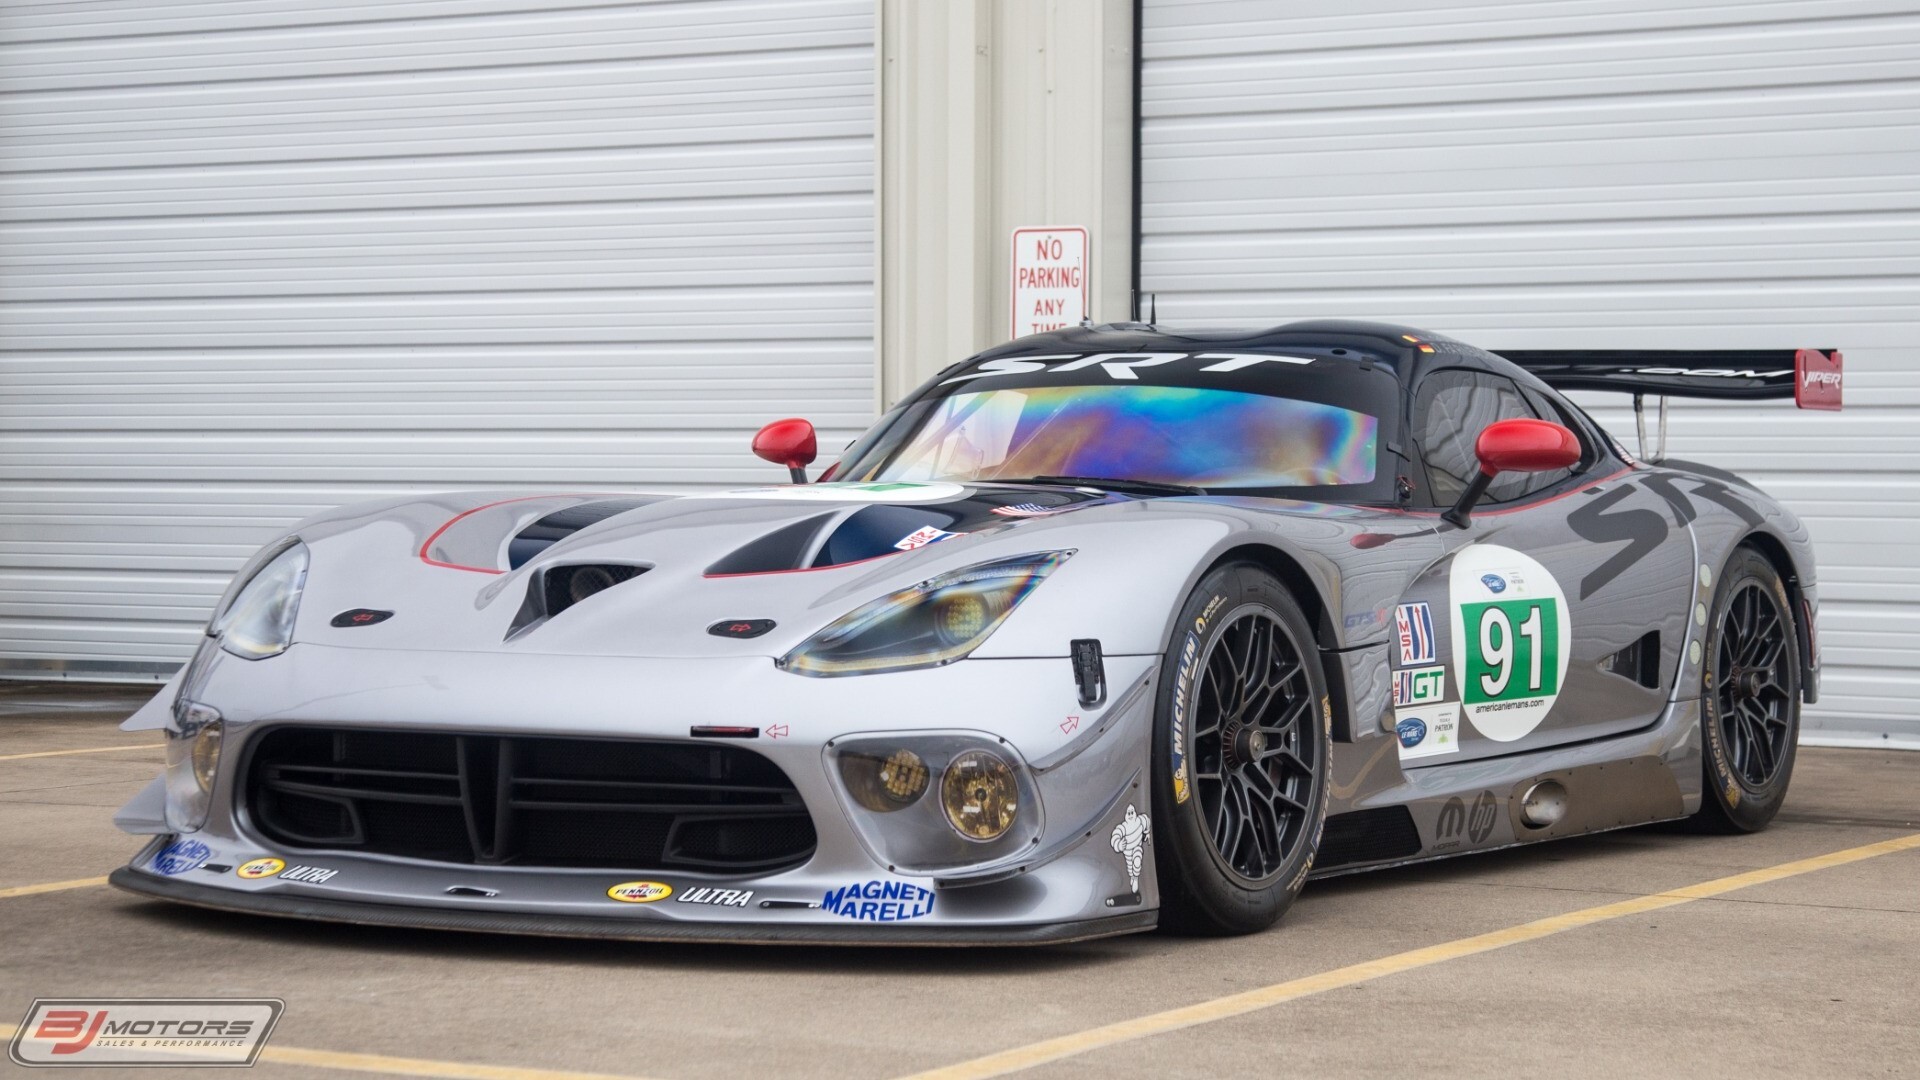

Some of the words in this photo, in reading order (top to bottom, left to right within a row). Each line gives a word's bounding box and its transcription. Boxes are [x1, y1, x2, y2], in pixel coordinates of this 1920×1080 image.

[1037, 239, 1063, 260] NO
[1019, 267, 1081, 289] PARKING
[1034, 299, 1065, 316] ANY
[938, 353, 1316, 386] SRT
[1801, 370, 1841, 390] VIPER
[1398, 606, 1413, 661] IMSA
[1479, 605, 1542, 698] 91
[1174, 636, 1196, 755] MICHELIN
[1413, 670, 1444, 699] GT
[280, 865, 339, 884] ULTRA
[615, 886, 664, 897] PENNZOIL
[677, 887, 754, 907] ULTRA
[821, 880, 935, 913] MAGNETI
[821, 899, 935, 921] MARELLI
